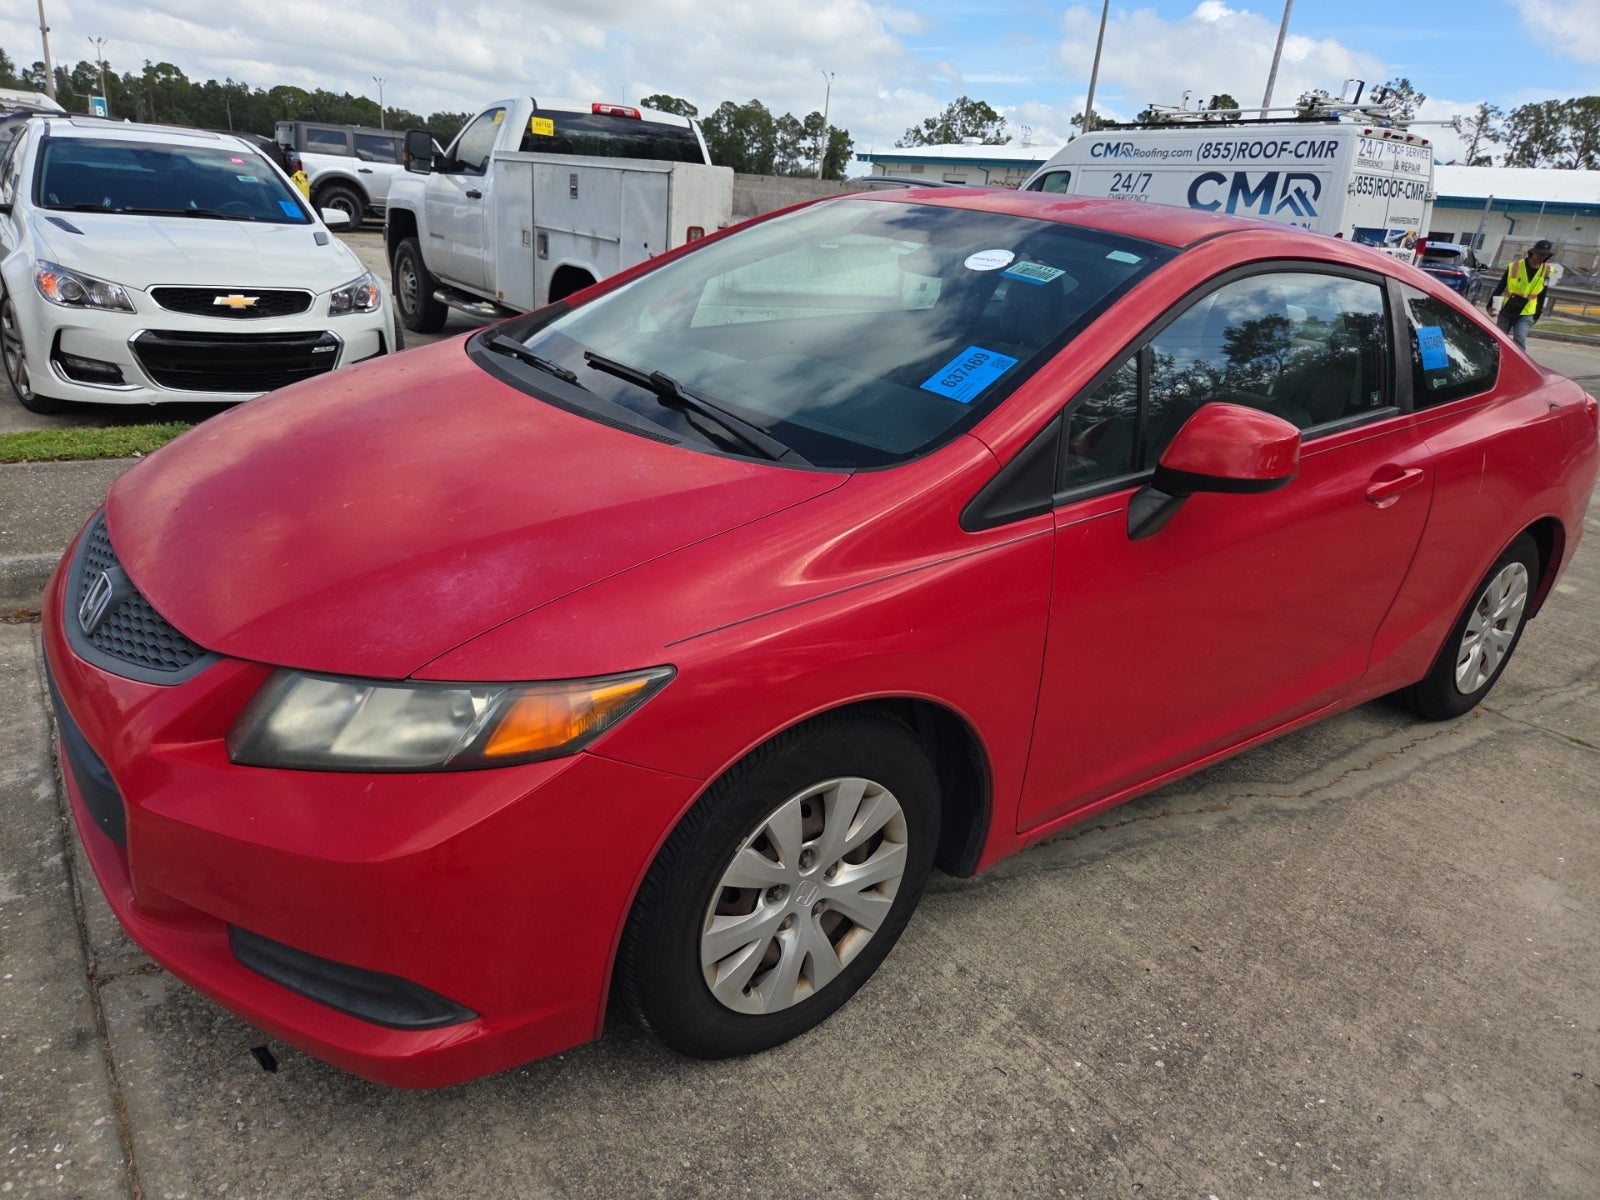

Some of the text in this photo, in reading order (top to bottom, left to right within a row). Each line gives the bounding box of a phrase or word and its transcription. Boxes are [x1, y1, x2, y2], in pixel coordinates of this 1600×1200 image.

[96, 105, 105, 116] B
[1196, 140, 1339, 162] (855)ROOF-CMR
[1359, 138, 1384, 160] 24/7
[1387, 143, 1429, 160] ROOF SERVICE
[1357, 158, 1384, 169] EMERGENCY
[1394, 160, 1421, 172] & REPAIR
[1110, 172, 1153, 193] 24/7
[1353, 175, 1425, 201] (855)ROOF-CMR
[1187, 171, 1322, 217] CMR
[941, 352, 990, 388] 637469
